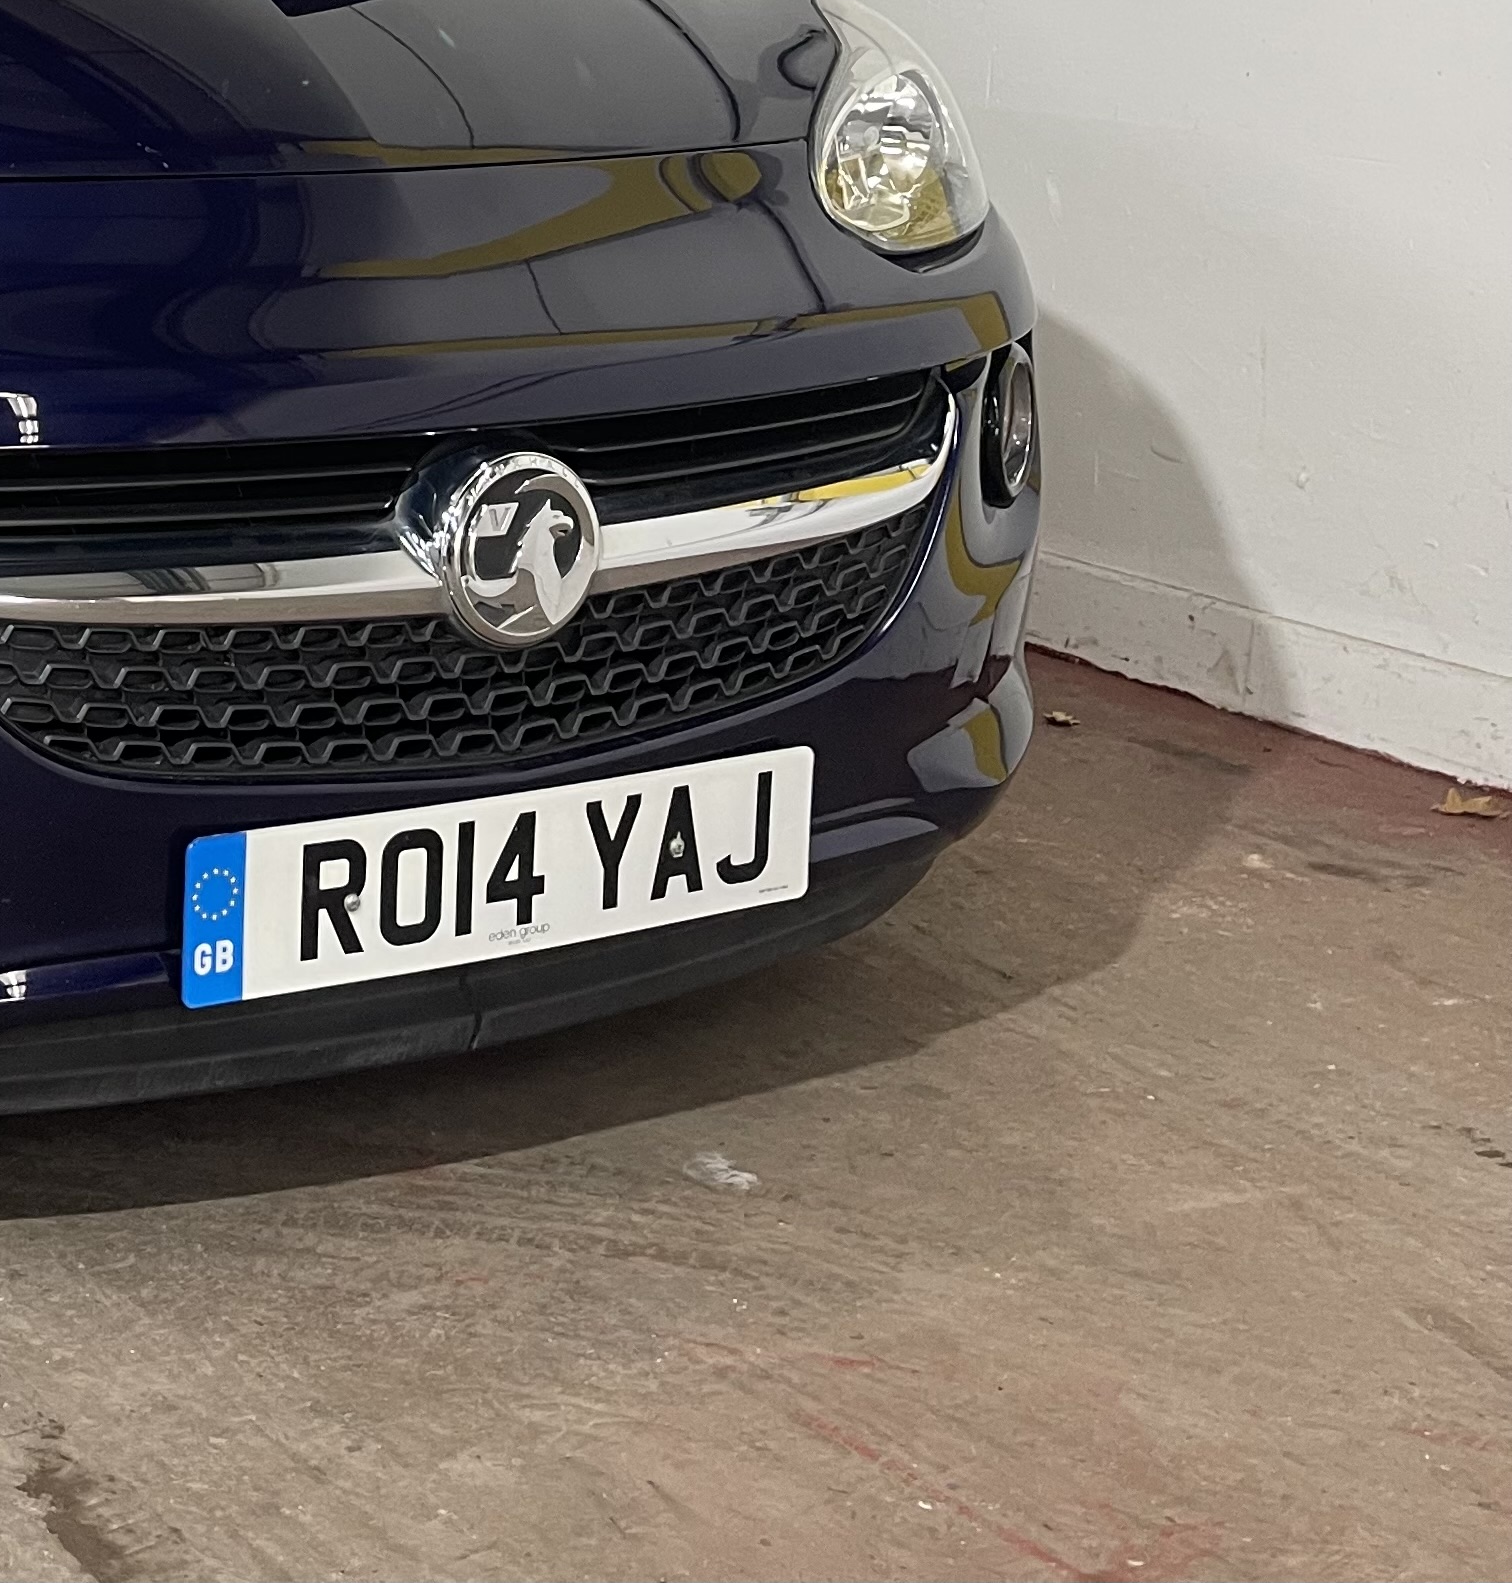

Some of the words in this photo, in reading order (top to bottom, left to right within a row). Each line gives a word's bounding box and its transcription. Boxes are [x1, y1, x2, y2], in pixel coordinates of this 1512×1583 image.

[489, 506, 512, 531] V
[300, 810, 545, 961] RO14
[586, 770, 773, 910] YAJ
[489, 928, 516, 942] eden
[519, 922, 550, 939] group
[193, 938, 235, 976] GB
